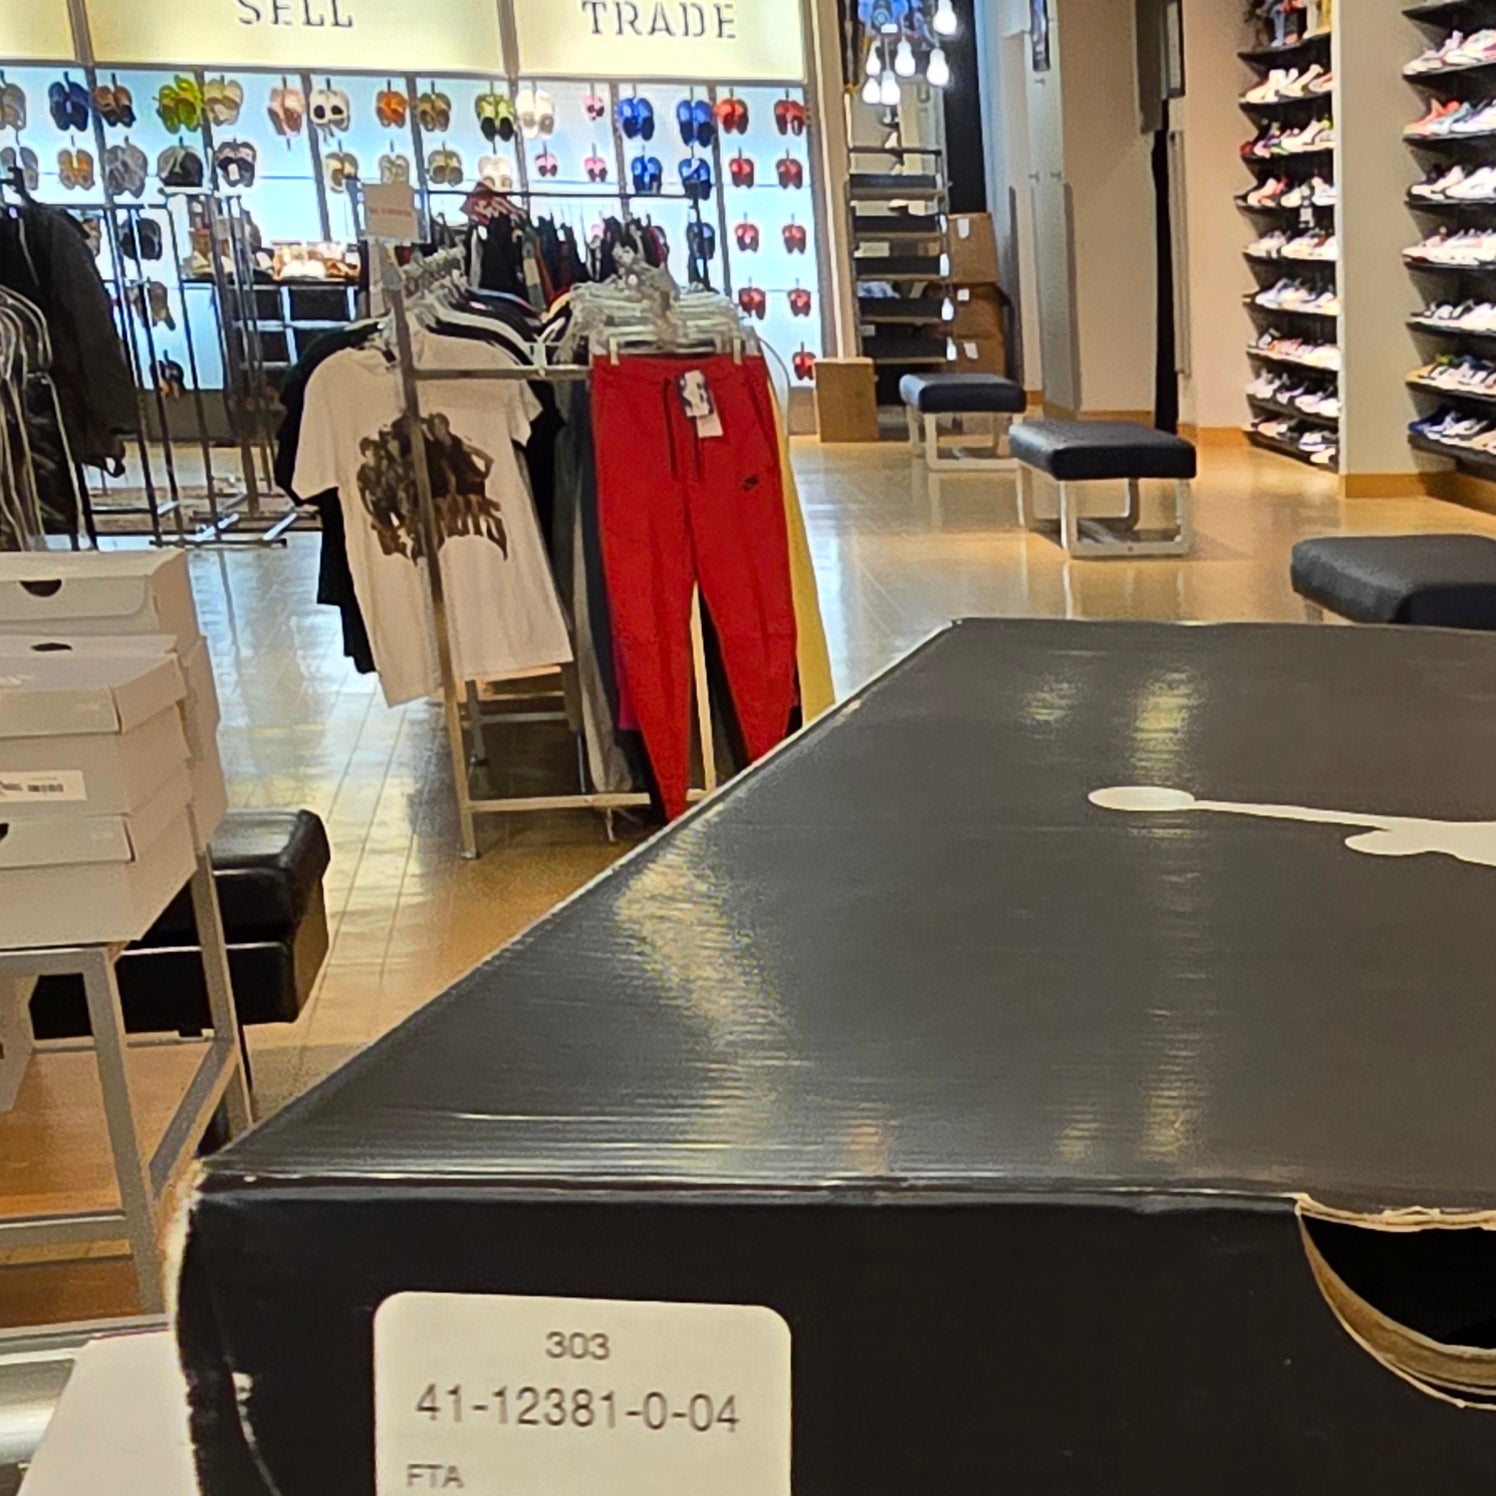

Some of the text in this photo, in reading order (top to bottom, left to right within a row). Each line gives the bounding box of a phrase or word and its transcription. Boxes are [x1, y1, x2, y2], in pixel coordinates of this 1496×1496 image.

[237, 0, 354, 28] SELL
[581, 1, 737, 39] TRADE
[545, 1331, 610, 1360] 303
[415, 1384, 740, 1433] 41-12381-0-04
[407, 1464, 464, 1488] FTA
